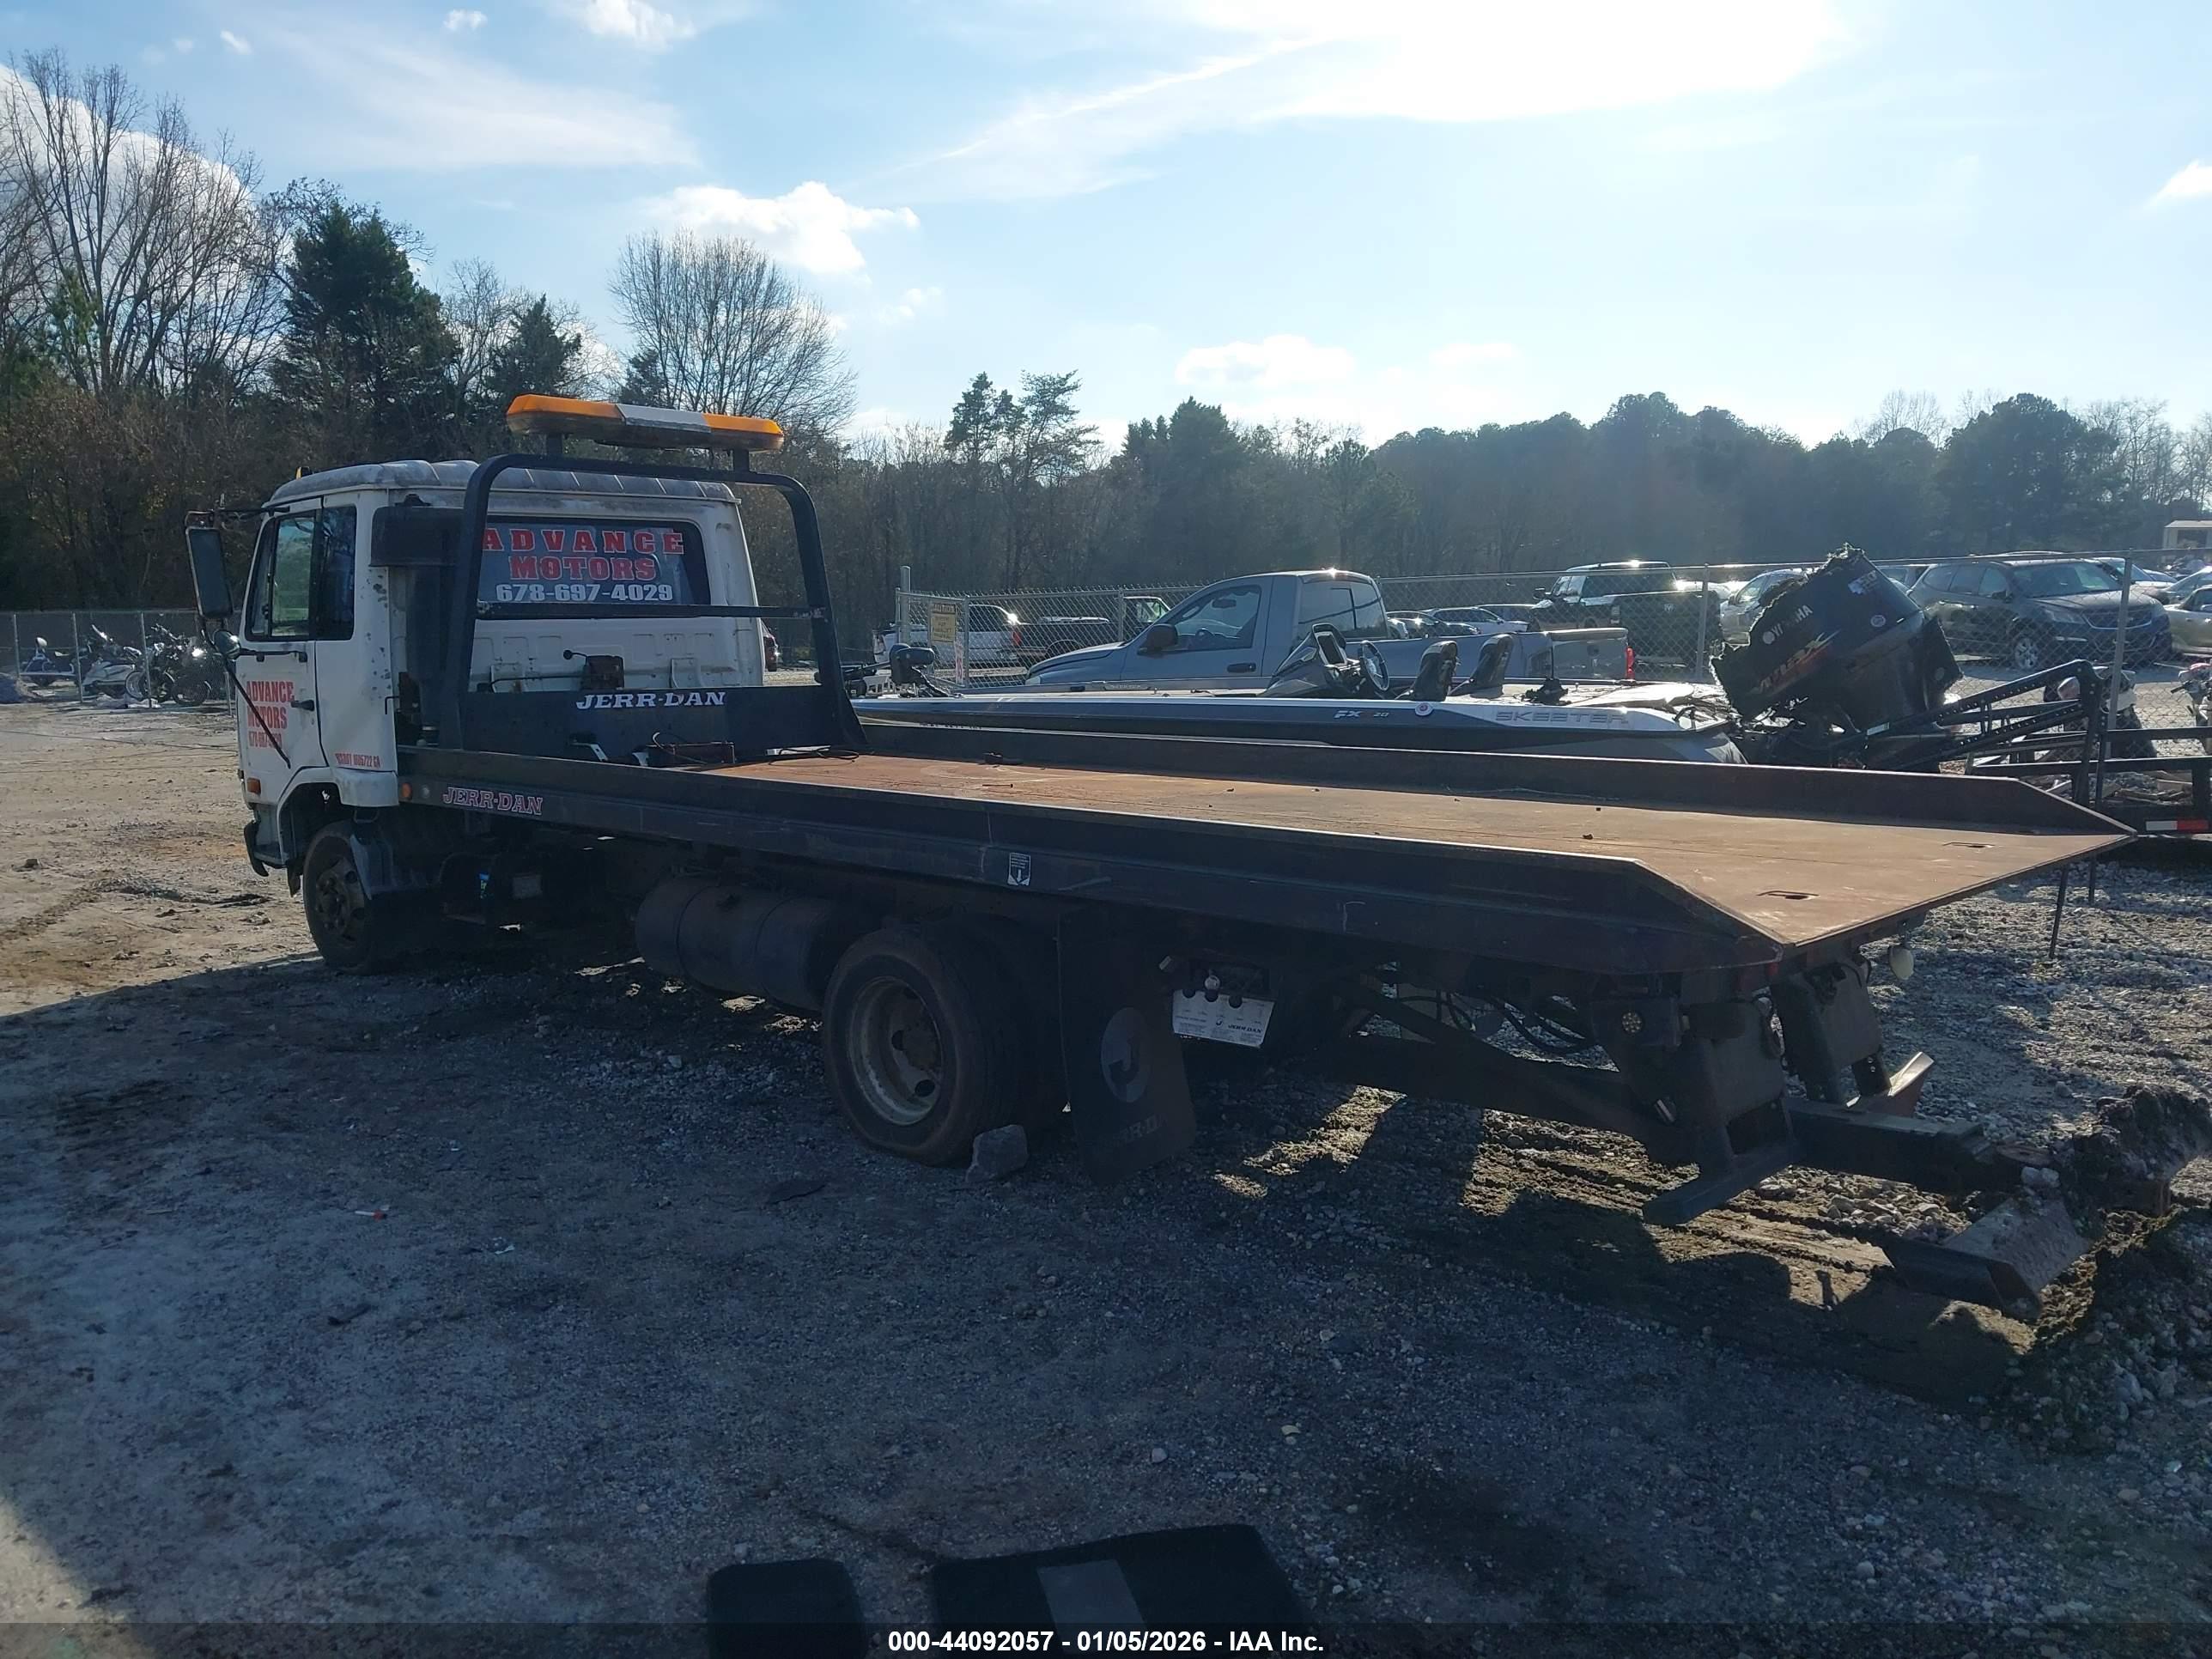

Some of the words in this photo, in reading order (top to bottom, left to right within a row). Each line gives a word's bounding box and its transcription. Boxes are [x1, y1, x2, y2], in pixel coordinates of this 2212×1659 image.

[481, 527, 684, 555] ADVANCE
[508, 556, 656, 581] MOTORS
[495, 583, 674, 602] 678-697-4029
[246, 681, 295, 702] ADVANCE
[575, 691, 726, 710] JERR-DAN
[246, 706, 287, 729] MOTORS
[1496, 711, 1629, 725] SKEETER
[441, 786, 544, 817] JERR-DAN
